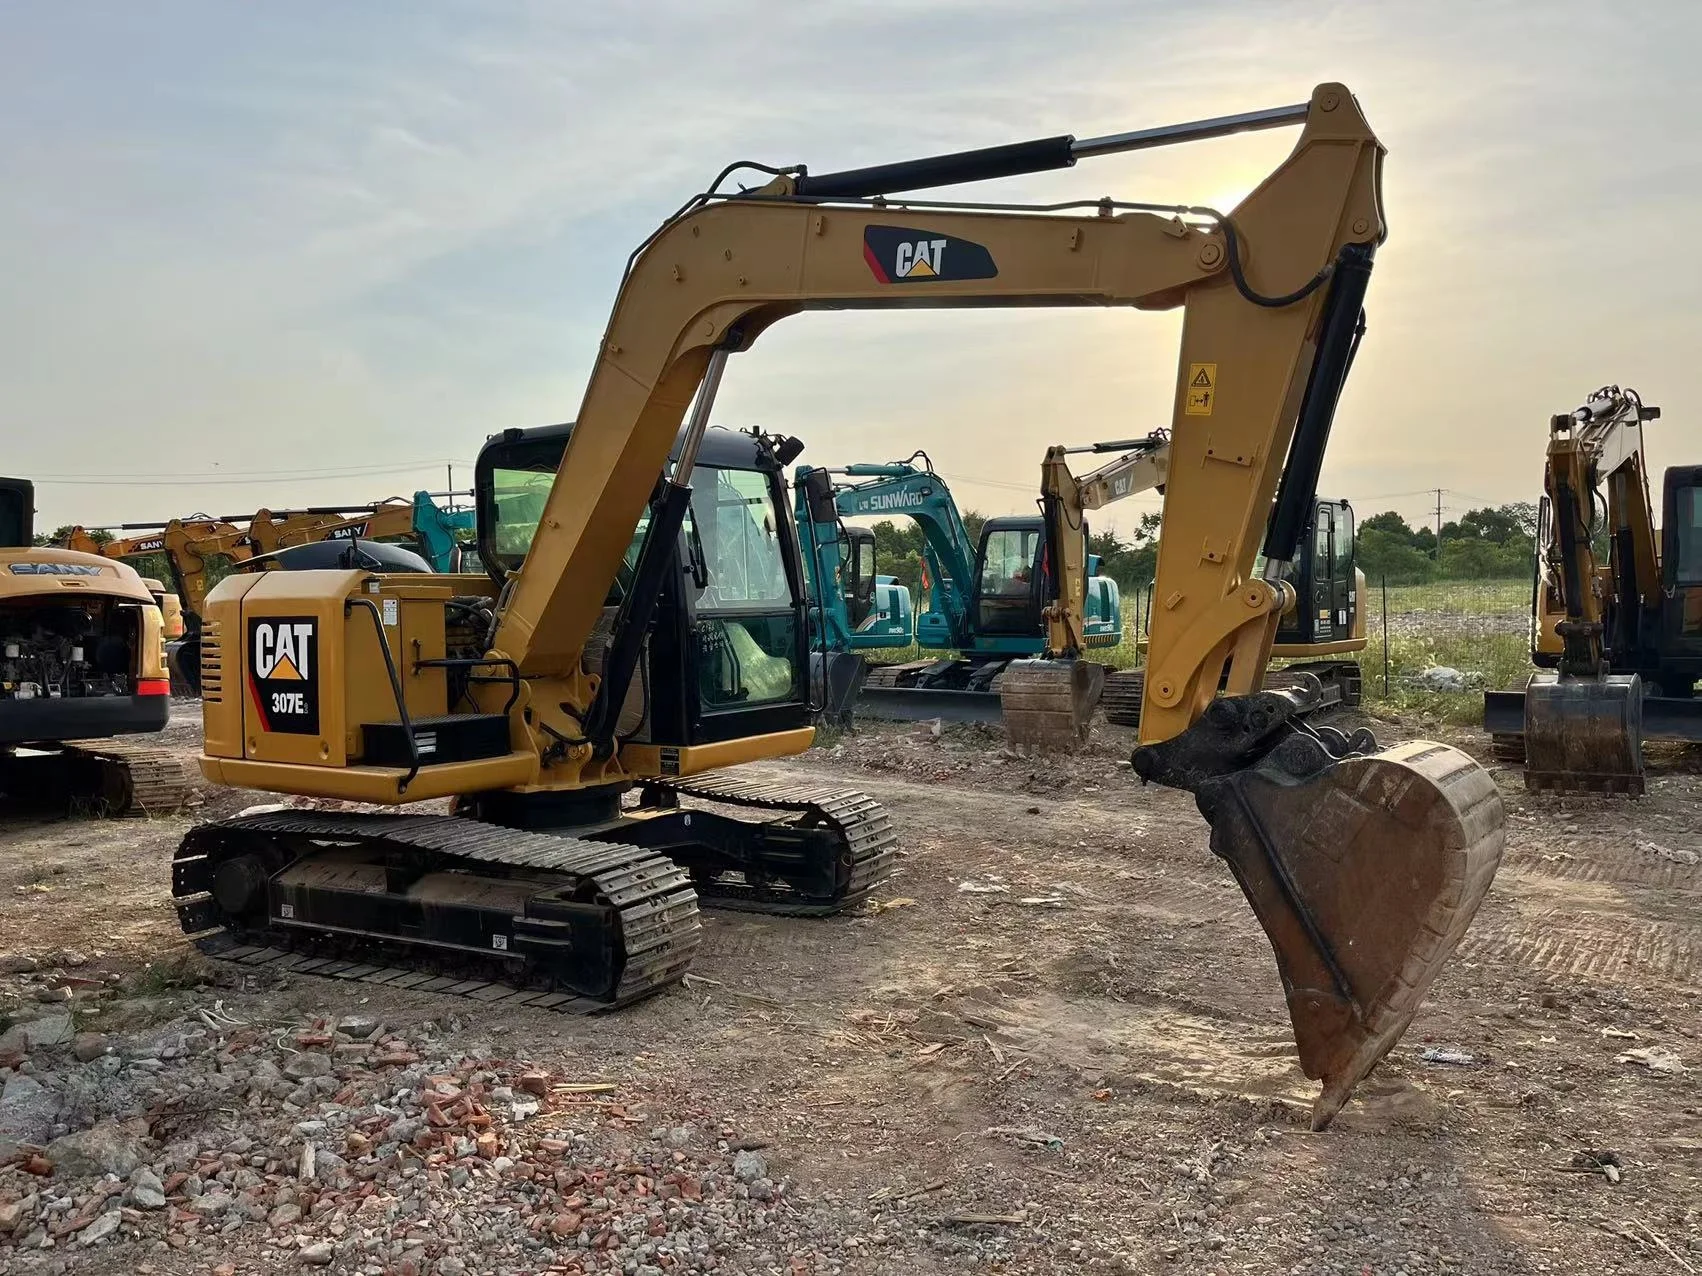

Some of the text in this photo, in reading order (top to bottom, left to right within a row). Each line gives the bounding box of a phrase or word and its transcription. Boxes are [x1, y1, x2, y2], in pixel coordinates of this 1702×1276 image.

[896, 239, 947, 278] CAT
[870, 485, 923, 510] SUNWARD
[9, 563, 103, 576] SANY
[255, 623, 313, 681] CAT
[271, 692, 304, 714] 307E
